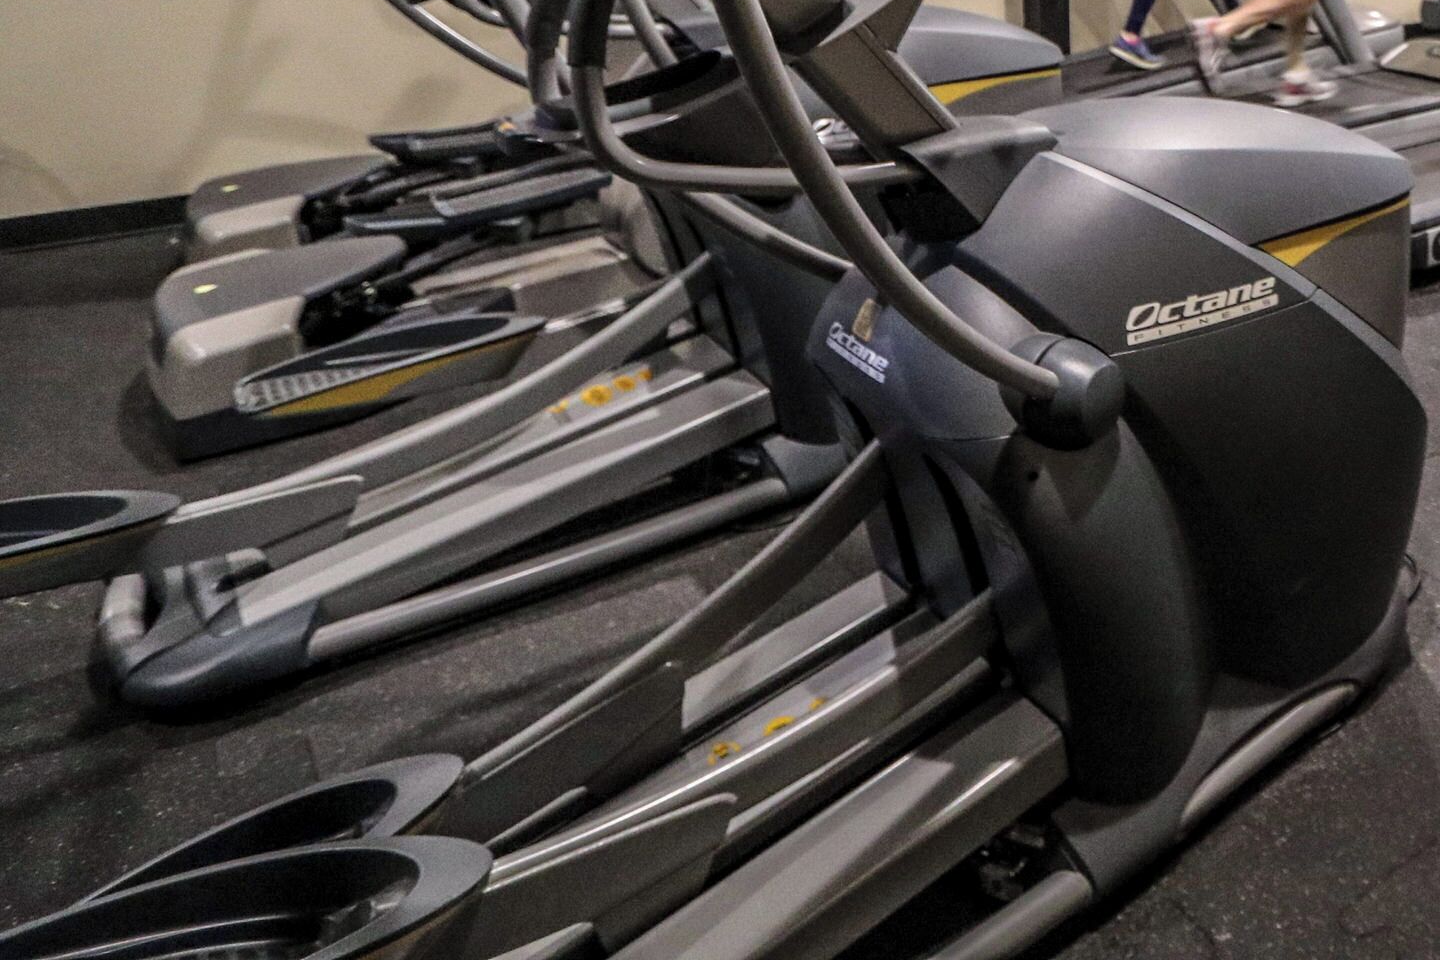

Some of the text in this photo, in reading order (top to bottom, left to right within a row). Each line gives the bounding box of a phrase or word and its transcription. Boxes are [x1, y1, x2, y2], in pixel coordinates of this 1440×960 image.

[1126, 277, 1276, 331] Octane
[1133, 298, 1271, 342] FITNESS
[828, 321, 890, 372] Octane
